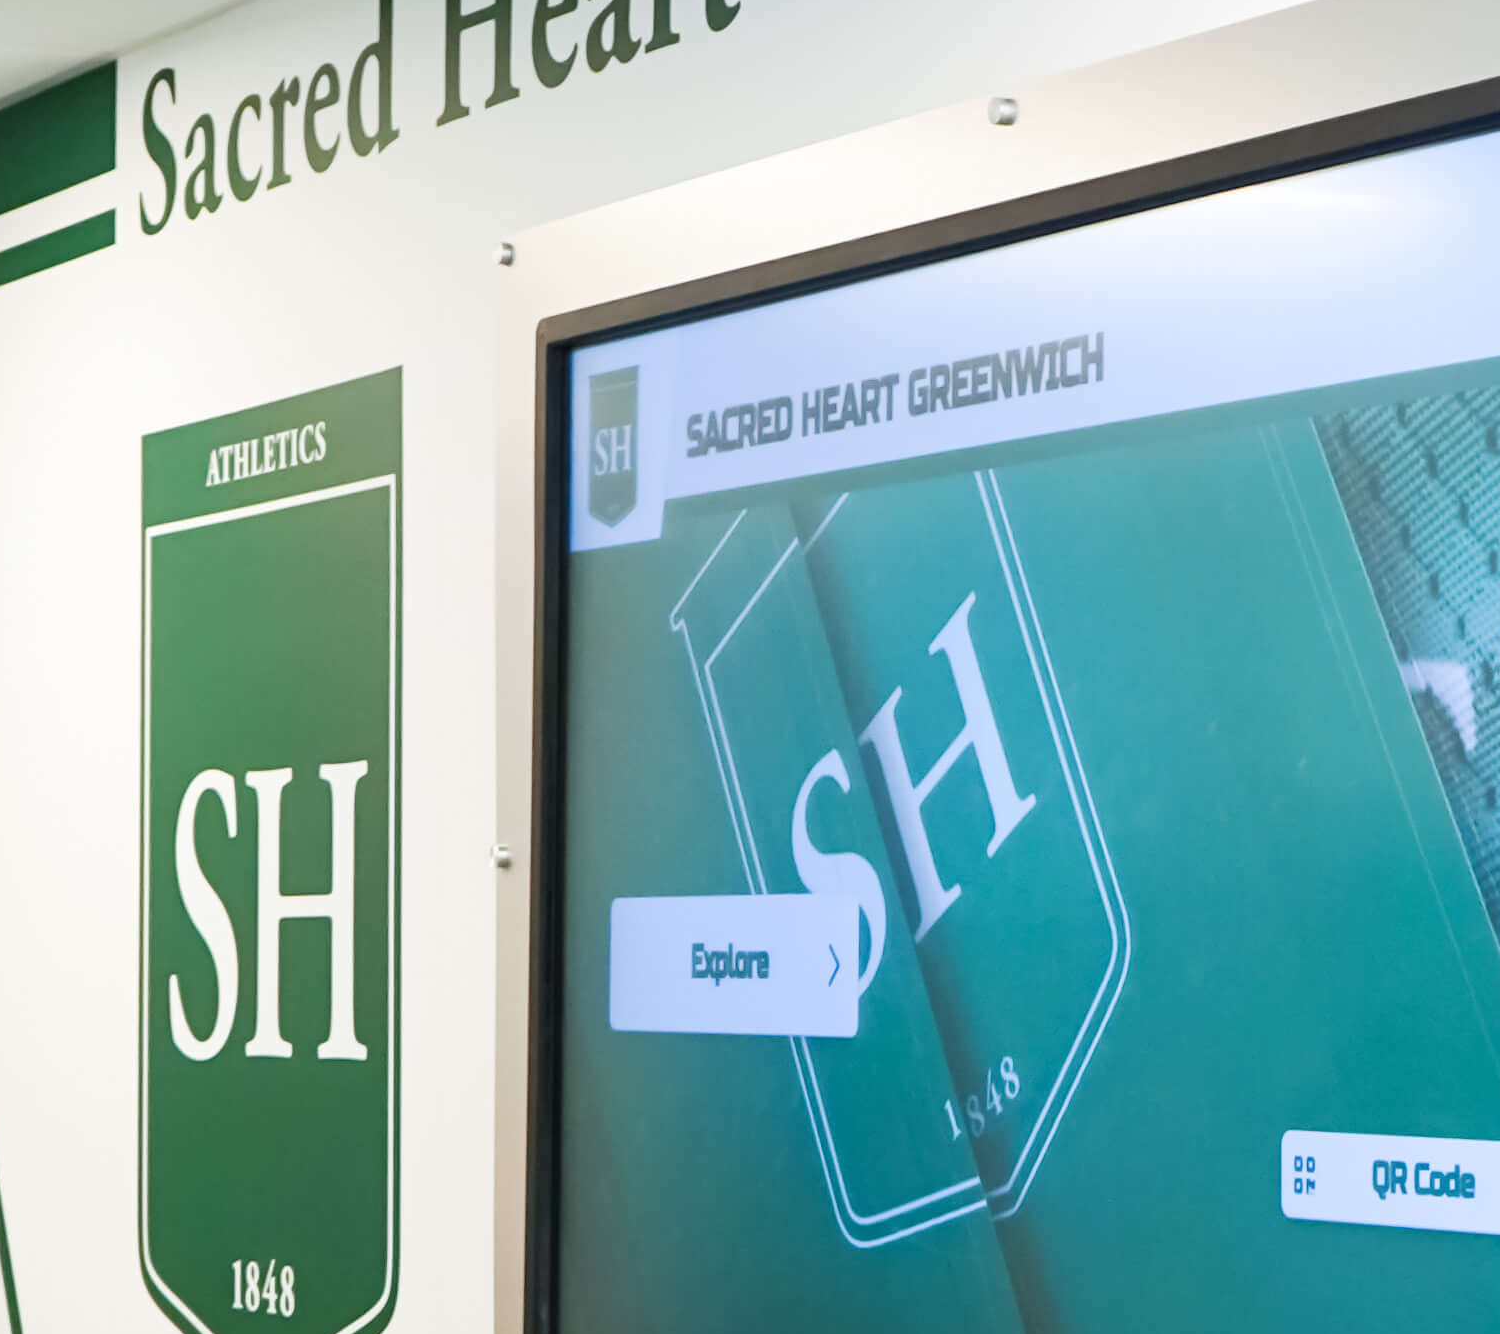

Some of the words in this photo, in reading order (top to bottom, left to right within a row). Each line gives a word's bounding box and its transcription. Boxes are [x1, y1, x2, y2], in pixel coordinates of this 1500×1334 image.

[686, 396, 793, 457] SACRED
[802, 373, 900, 437] HEART
[908, 332, 1105, 417] GREENWICH
[205, 421, 327, 487] ATHLETICS
[594, 423, 632, 476] SH
[169, 760, 368, 1061] SH
[692, 942, 769, 987] Explore
[943, 1055, 1020, 1140] 1848
[1372, 1160, 1407, 1199] QR
[1414, 1163, 1476, 1199] Code
[231, 1259, 295, 1318] 1848
